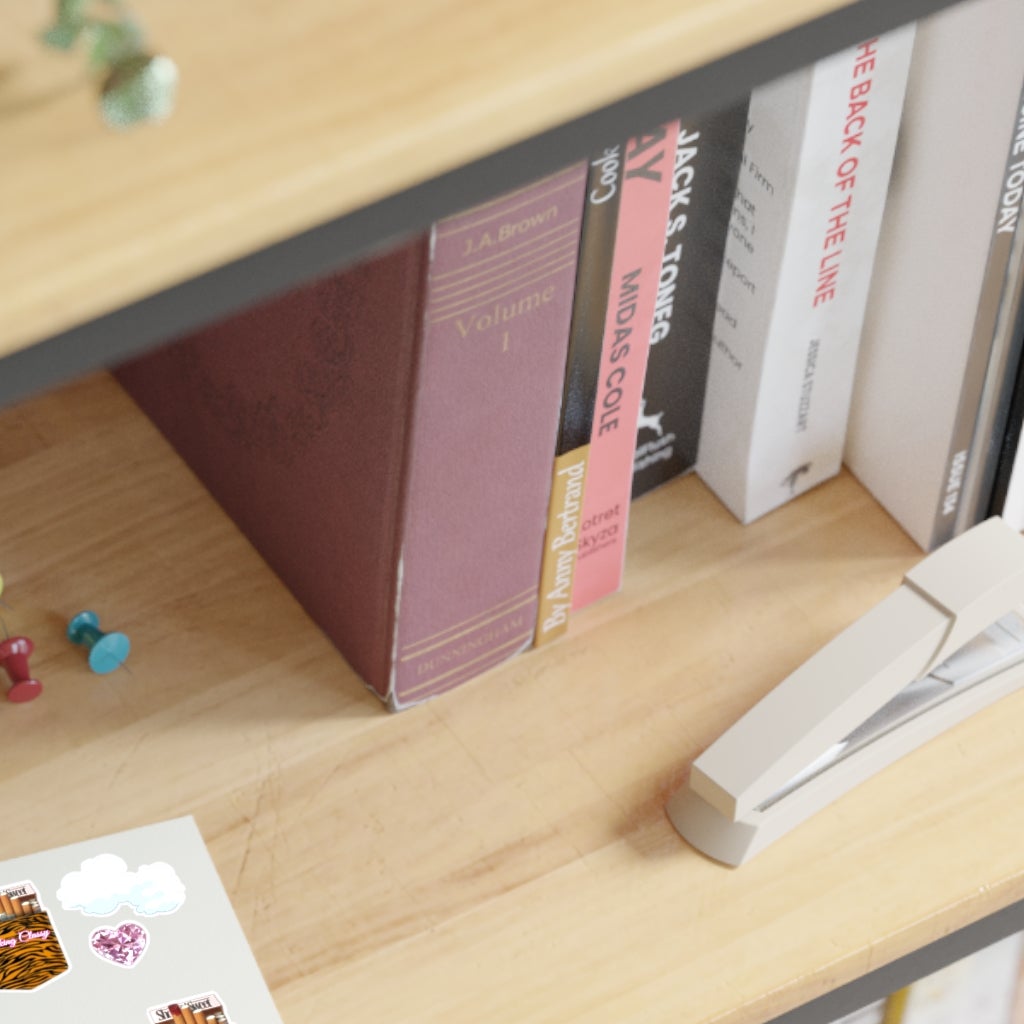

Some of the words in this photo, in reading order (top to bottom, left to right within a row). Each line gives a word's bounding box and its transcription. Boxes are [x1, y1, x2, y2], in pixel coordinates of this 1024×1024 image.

[840, 79, 872, 154] BACK
[589, 145, 620, 205] Cook
[669, 129, 700, 212] JACK
[835, 157, 859, 191] OF
[996, 160, 1024, 234] TODAY
[824, 195, 852, 250] THE
[813, 249, 843, 308] LINE
[455, 284, 556, 339] Volume
[608, 267, 643, 364] MIDAS
[598, 367, 626, 438] COLE
[551, 460, 585, 551] Bertrand
[542, 602, 573, 633] By
[18, 929, 50, 943] Classy
